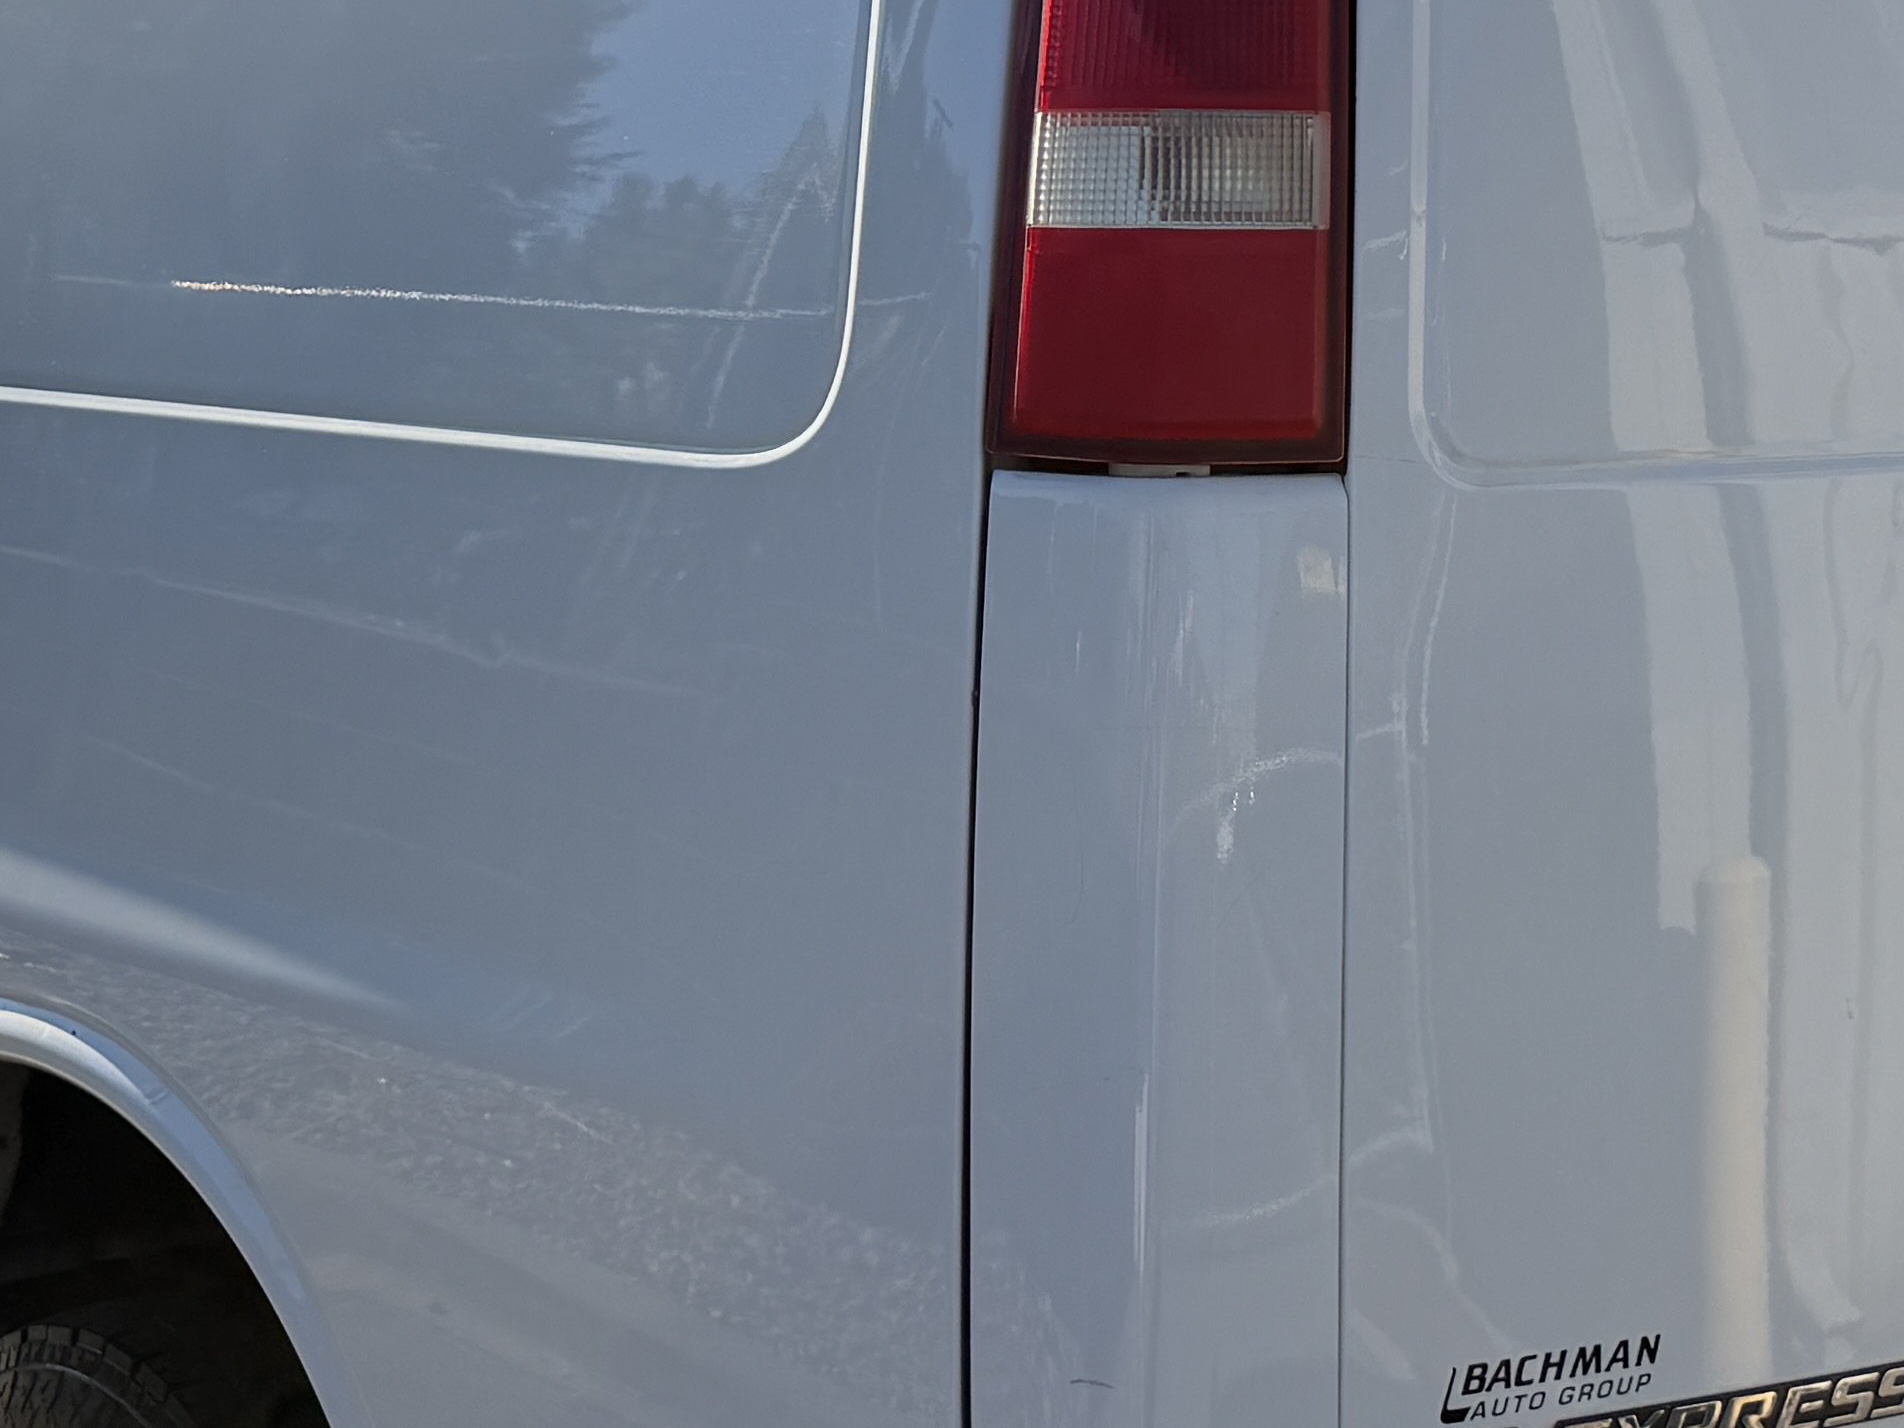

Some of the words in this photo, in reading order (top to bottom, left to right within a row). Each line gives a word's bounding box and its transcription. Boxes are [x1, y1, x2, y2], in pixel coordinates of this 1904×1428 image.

[1461, 1334, 1661, 1395] BACHMAN
[1470, 1391, 1546, 1421] AUTO
[1558, 1373, 1652, 1406] GROUP
